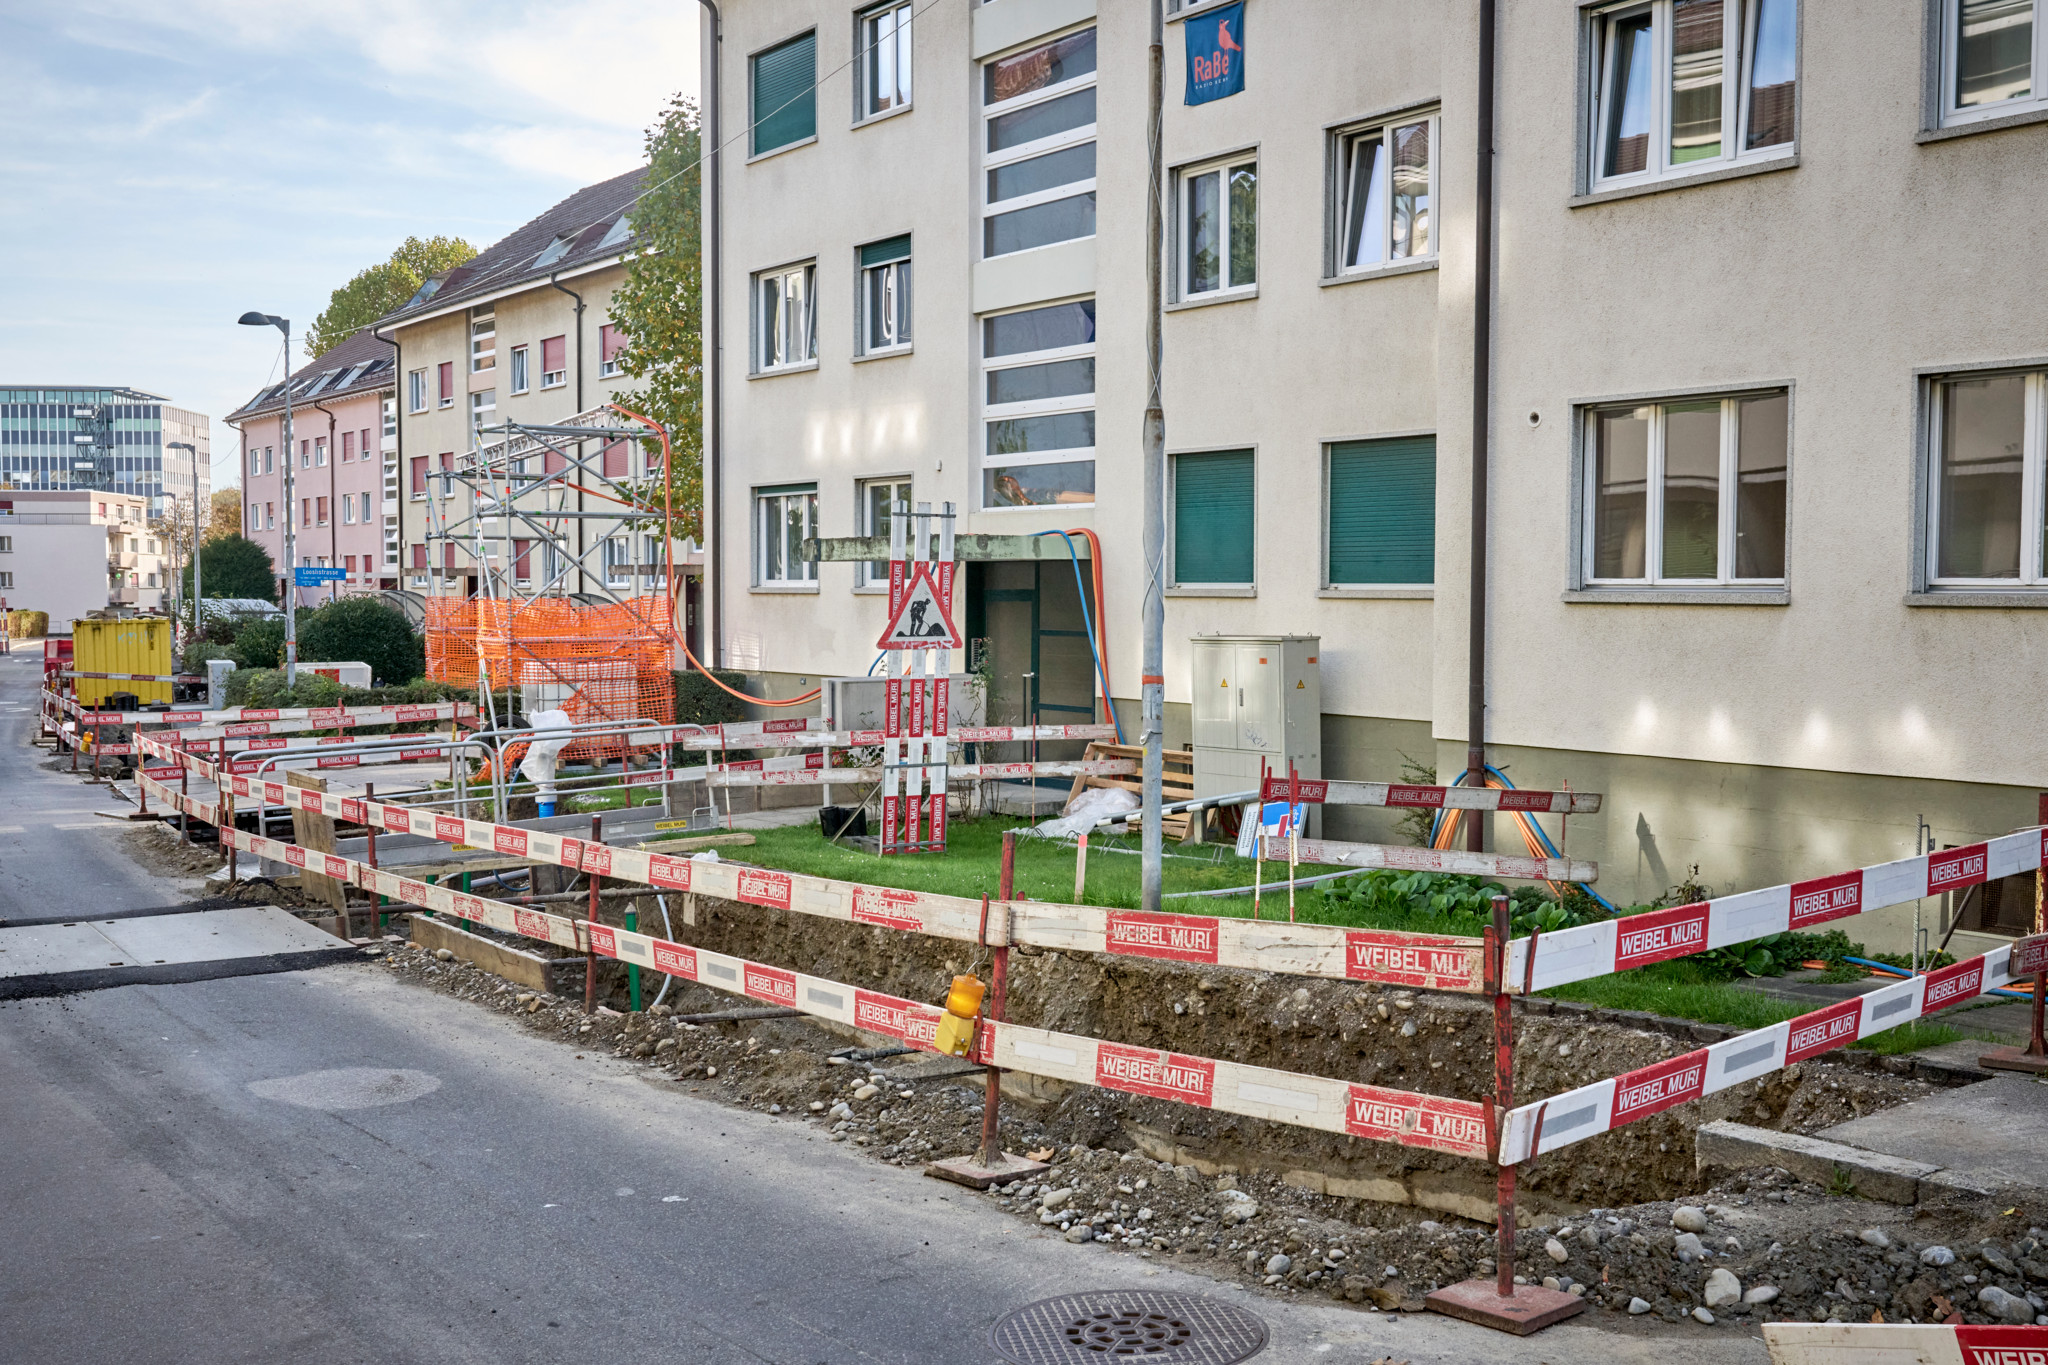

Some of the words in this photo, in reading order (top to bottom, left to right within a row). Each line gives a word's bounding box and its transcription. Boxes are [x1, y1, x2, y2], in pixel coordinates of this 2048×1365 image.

[1194, 50, 1229, 83] RaBe
[765, 722, 788, 731] WEIBEL
[890, 705, 898, 734] WEIBEL
[1300, 786, 1324, 796] MURI
[1391, 791, 1419, 801] WEIBEL
[1420, 792, 1442, 801] MURI
[1502, 796, 1529, 805] WEIBEL
[1530, 797, 1549, 806] MURI
[496, 835, 512, 847] WEIBEL
[513, 837, 526, 849] MURI
[564, 847, 577, 858] WEIB
[651, 864, 671, 878] WEIBEL
[672, 868, 688, 882] MURI
[1931, 860, 1962, 883] WEIBEL
[1963, 856, 1984, 876] MURI
[741, 879, 766, 896] WEIBEL
[768, 883, 787, 899] MURI
[855, 896, 888, 916] WEIBEL
[1793, 892, 1830, 916] WEIBEL
[1832, 885, 1857, 906] MURI
[600, 934, 613, 949] MURI
[1113, 923, 1167, 945] WEIBEL
[1171, 928, 1210, 950] MURI
[1621, 929, 1668, 956] WEIBEL
[1671, 920, 1702, 944] MURI
[656, 949, 678, 966] WEIBEL
[678, 955, 695, 971] MURI
[1355, 945, 1426, 971] WEIBEL
[1431, 952, 1471, 976] MUR
[747, 975, 774, 993] WEIBEL
[774, 980, 794, 999] MURI
[1928, 980, 1957, 1003] WEIBEL
[1958, 971, 1979, 990] MURI
[858, 1003, 891, 1025] WEIBEL
[908, 1020, 938, 1041] WEIB
[1791, 1026, 1827, 1051] WEIBEL
[1830, 1014, 1856, 1033] MURI
[1102, 1055, 1160, 1083] WEIBEL
[1163, 1066, 1205, 1092] MURI
[1619, 1084, 1665, 1111] WEIBEL
[1667, 1067, 1700, 1095] MURI
